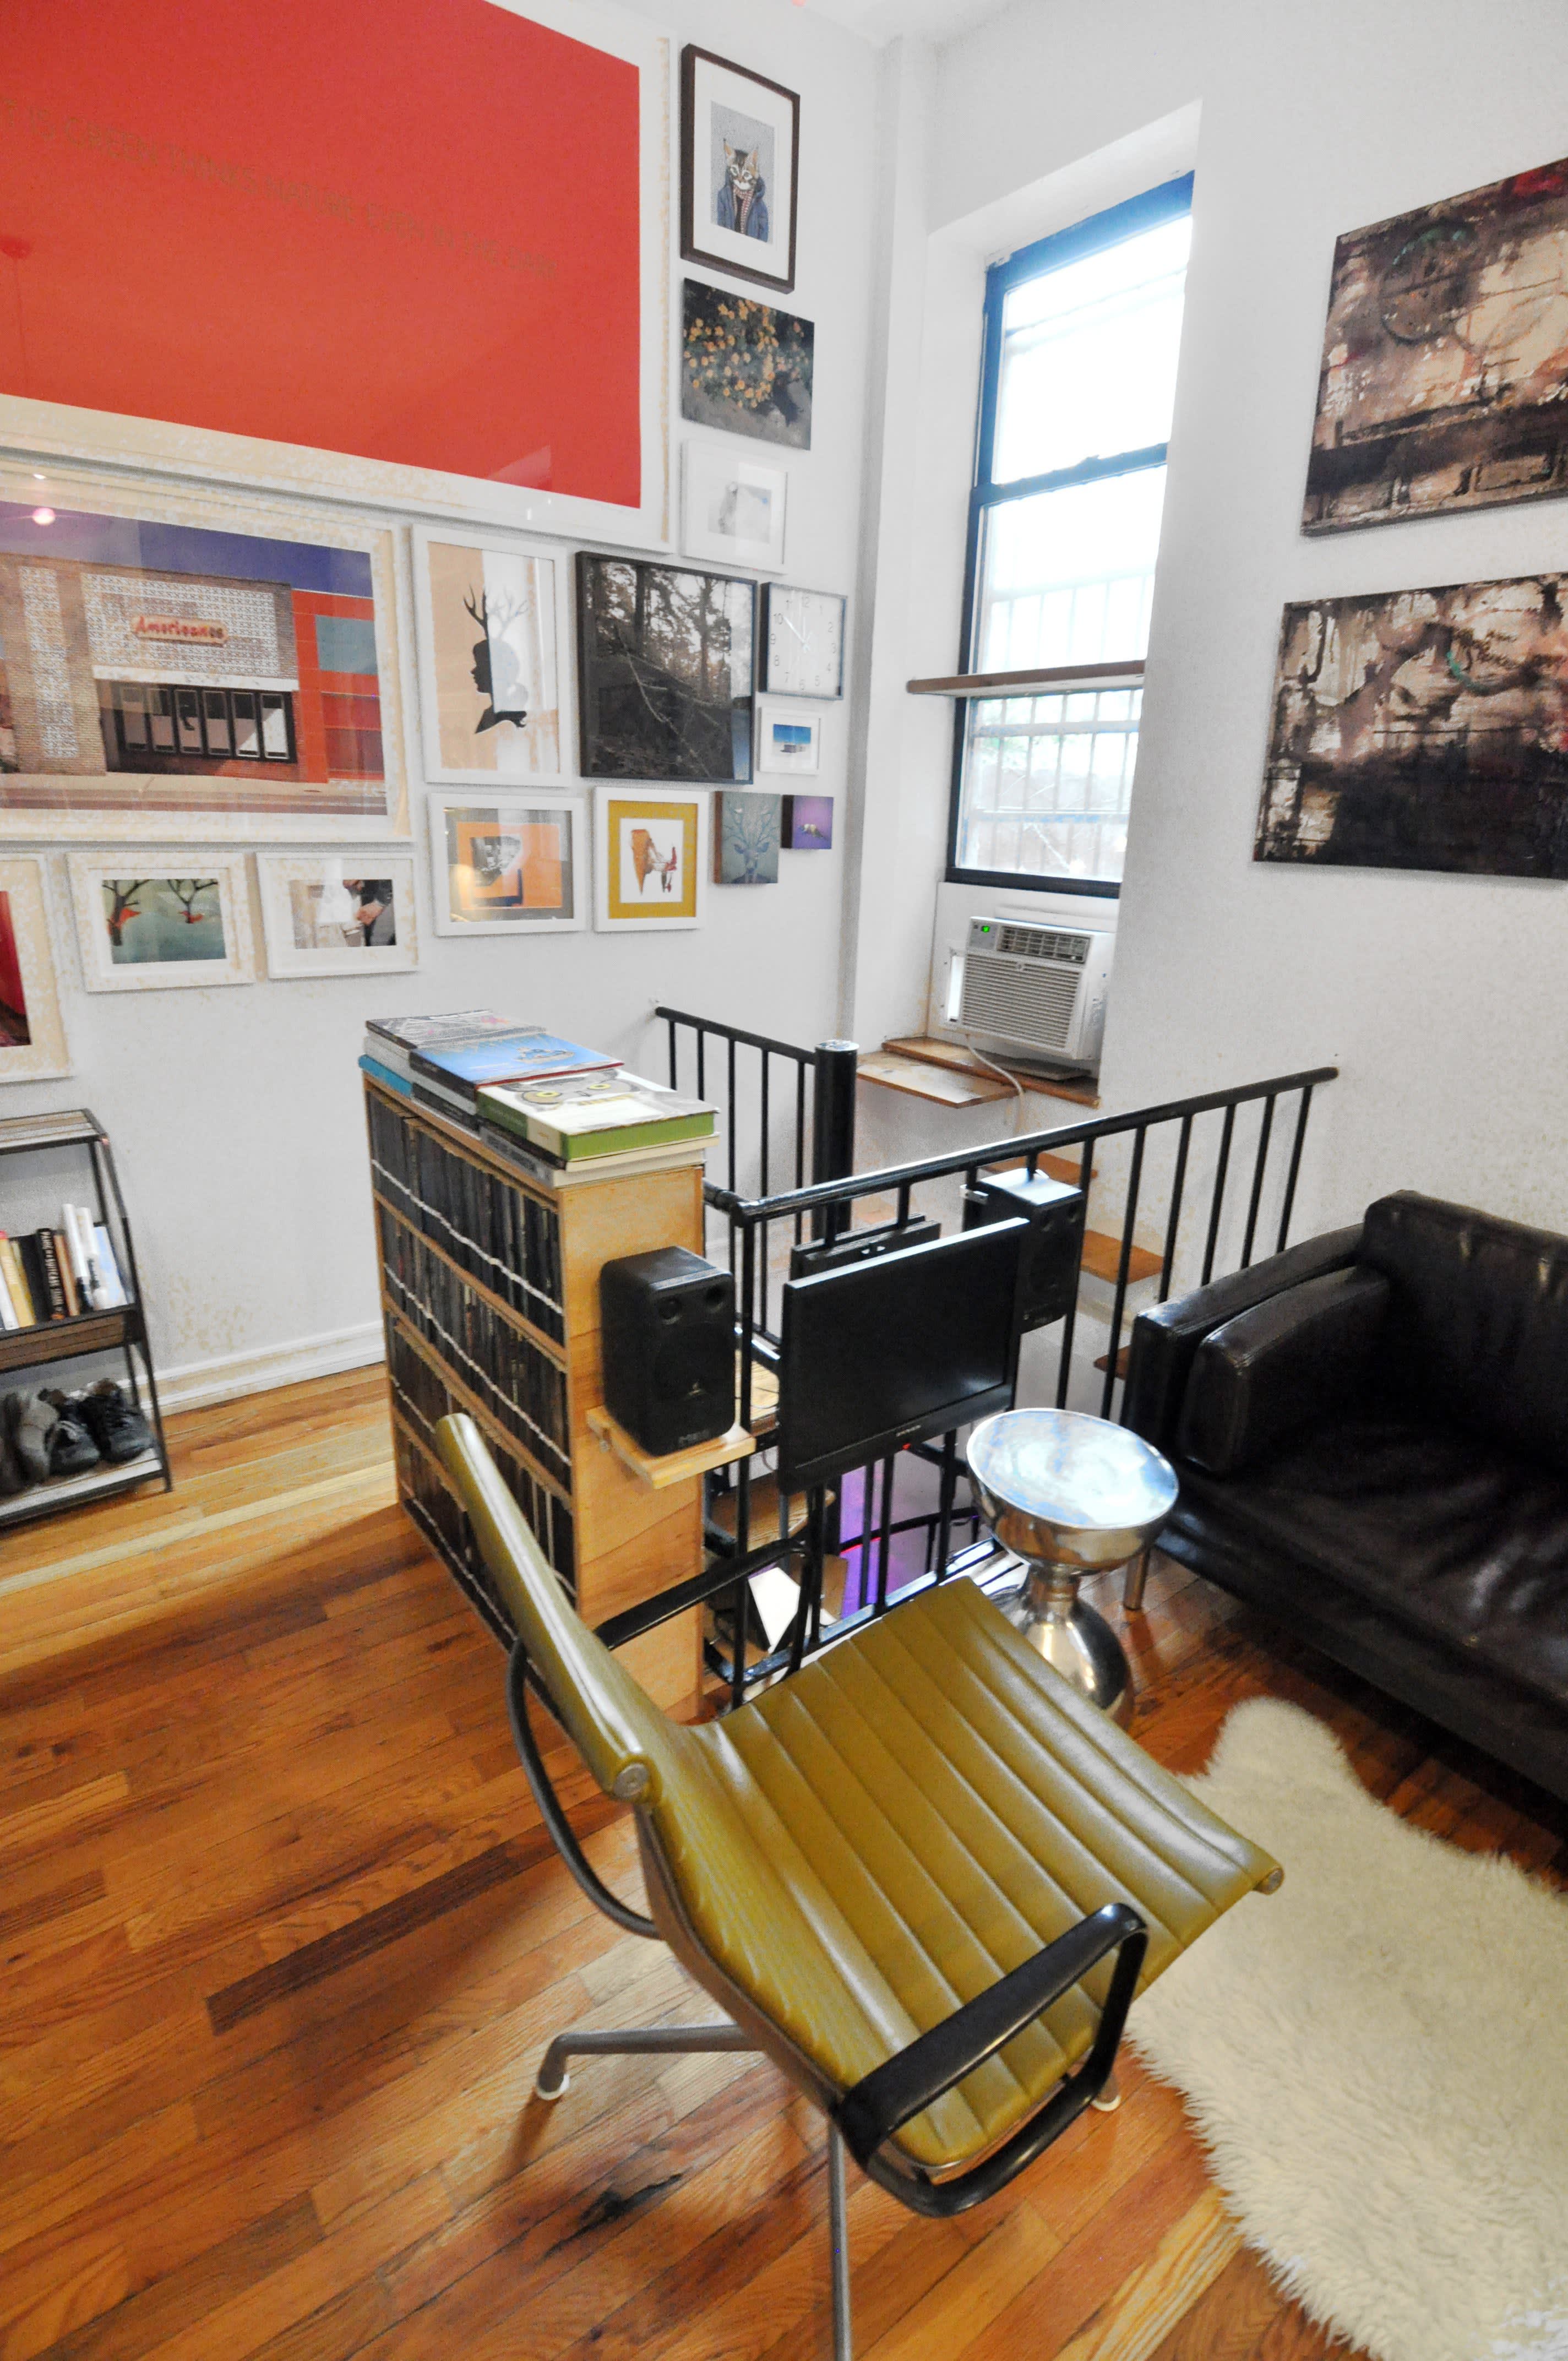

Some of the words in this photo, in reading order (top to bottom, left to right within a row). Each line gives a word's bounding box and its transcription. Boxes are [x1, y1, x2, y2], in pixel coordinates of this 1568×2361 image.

[28, 105, 56, 140] IS
[164, 140, 258, 195] THINKS
[263, 173, 357, 225] NATURE
[366, 202, 425, 241] EVEN
[433, 222, 455, 249] IN
[462, 230, 499, 266] THE
[802, 596, 809, 608] 12
[774, 613, 783, 625] 10
[827, 622, 833, 633] 2
[770, 633, 776, 645] 9
[831, 643, 837, 654] 3
[775, 655, 780, 667] 8
